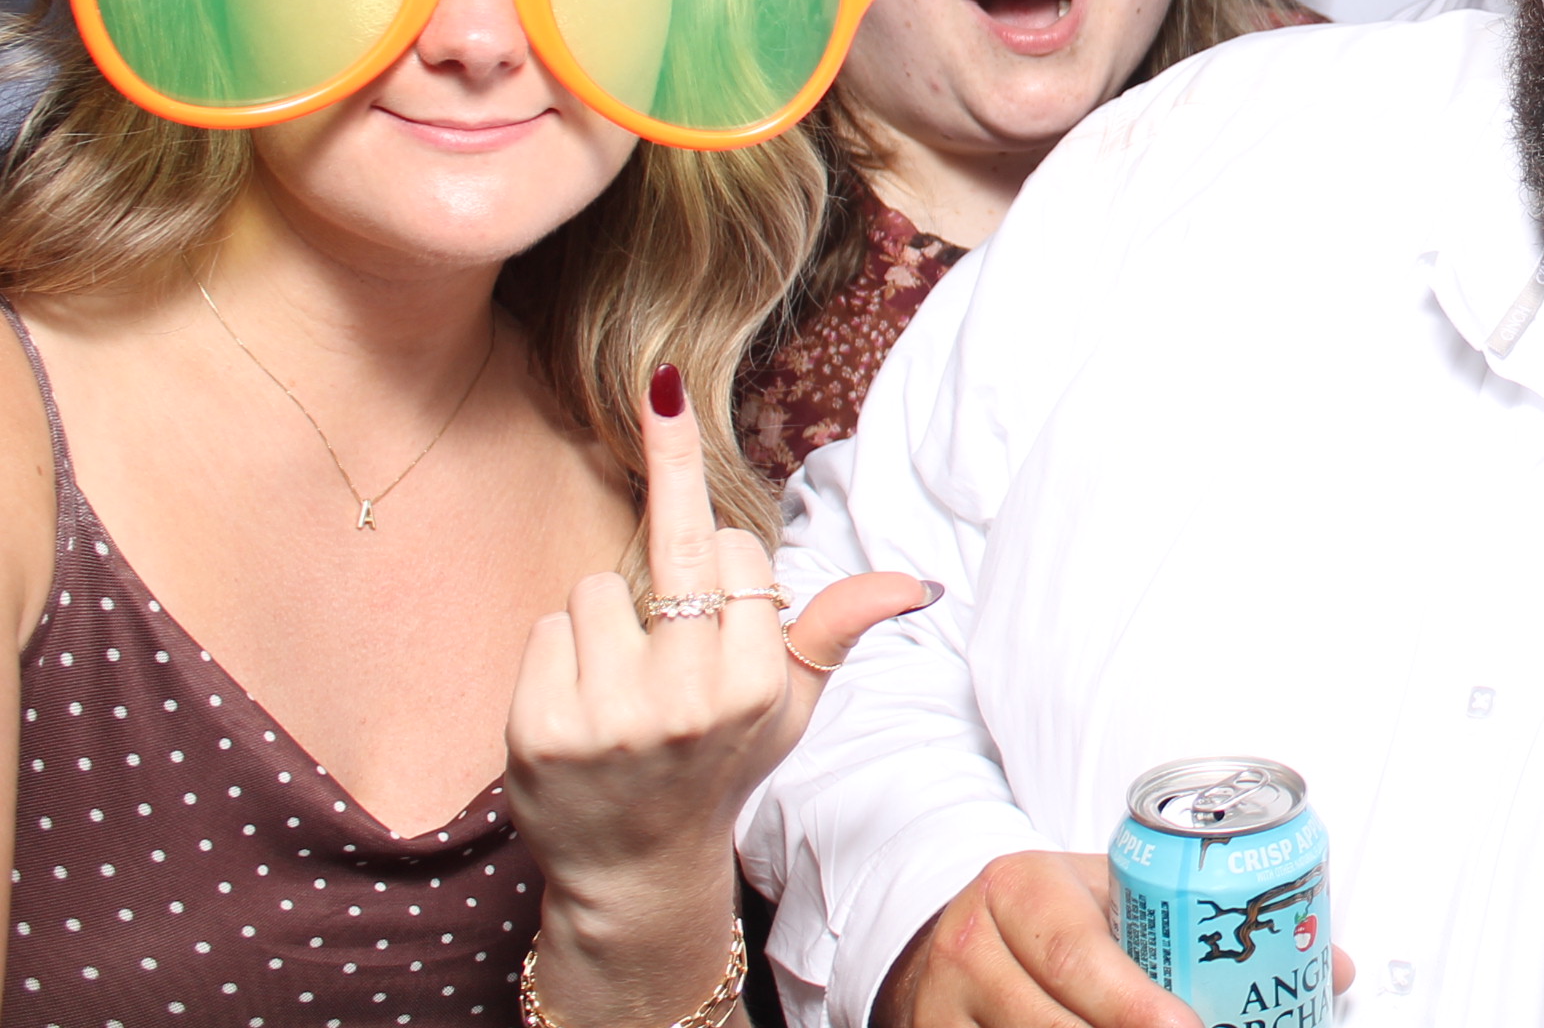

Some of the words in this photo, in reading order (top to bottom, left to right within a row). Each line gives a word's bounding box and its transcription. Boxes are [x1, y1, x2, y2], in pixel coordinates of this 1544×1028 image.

[356, 499, 376, 531] A
[1227, 838, 1293, 875] CRISP
[1295, 817, 1321, 854] APP
[1240, 944, 1330, 1016] ANGR
